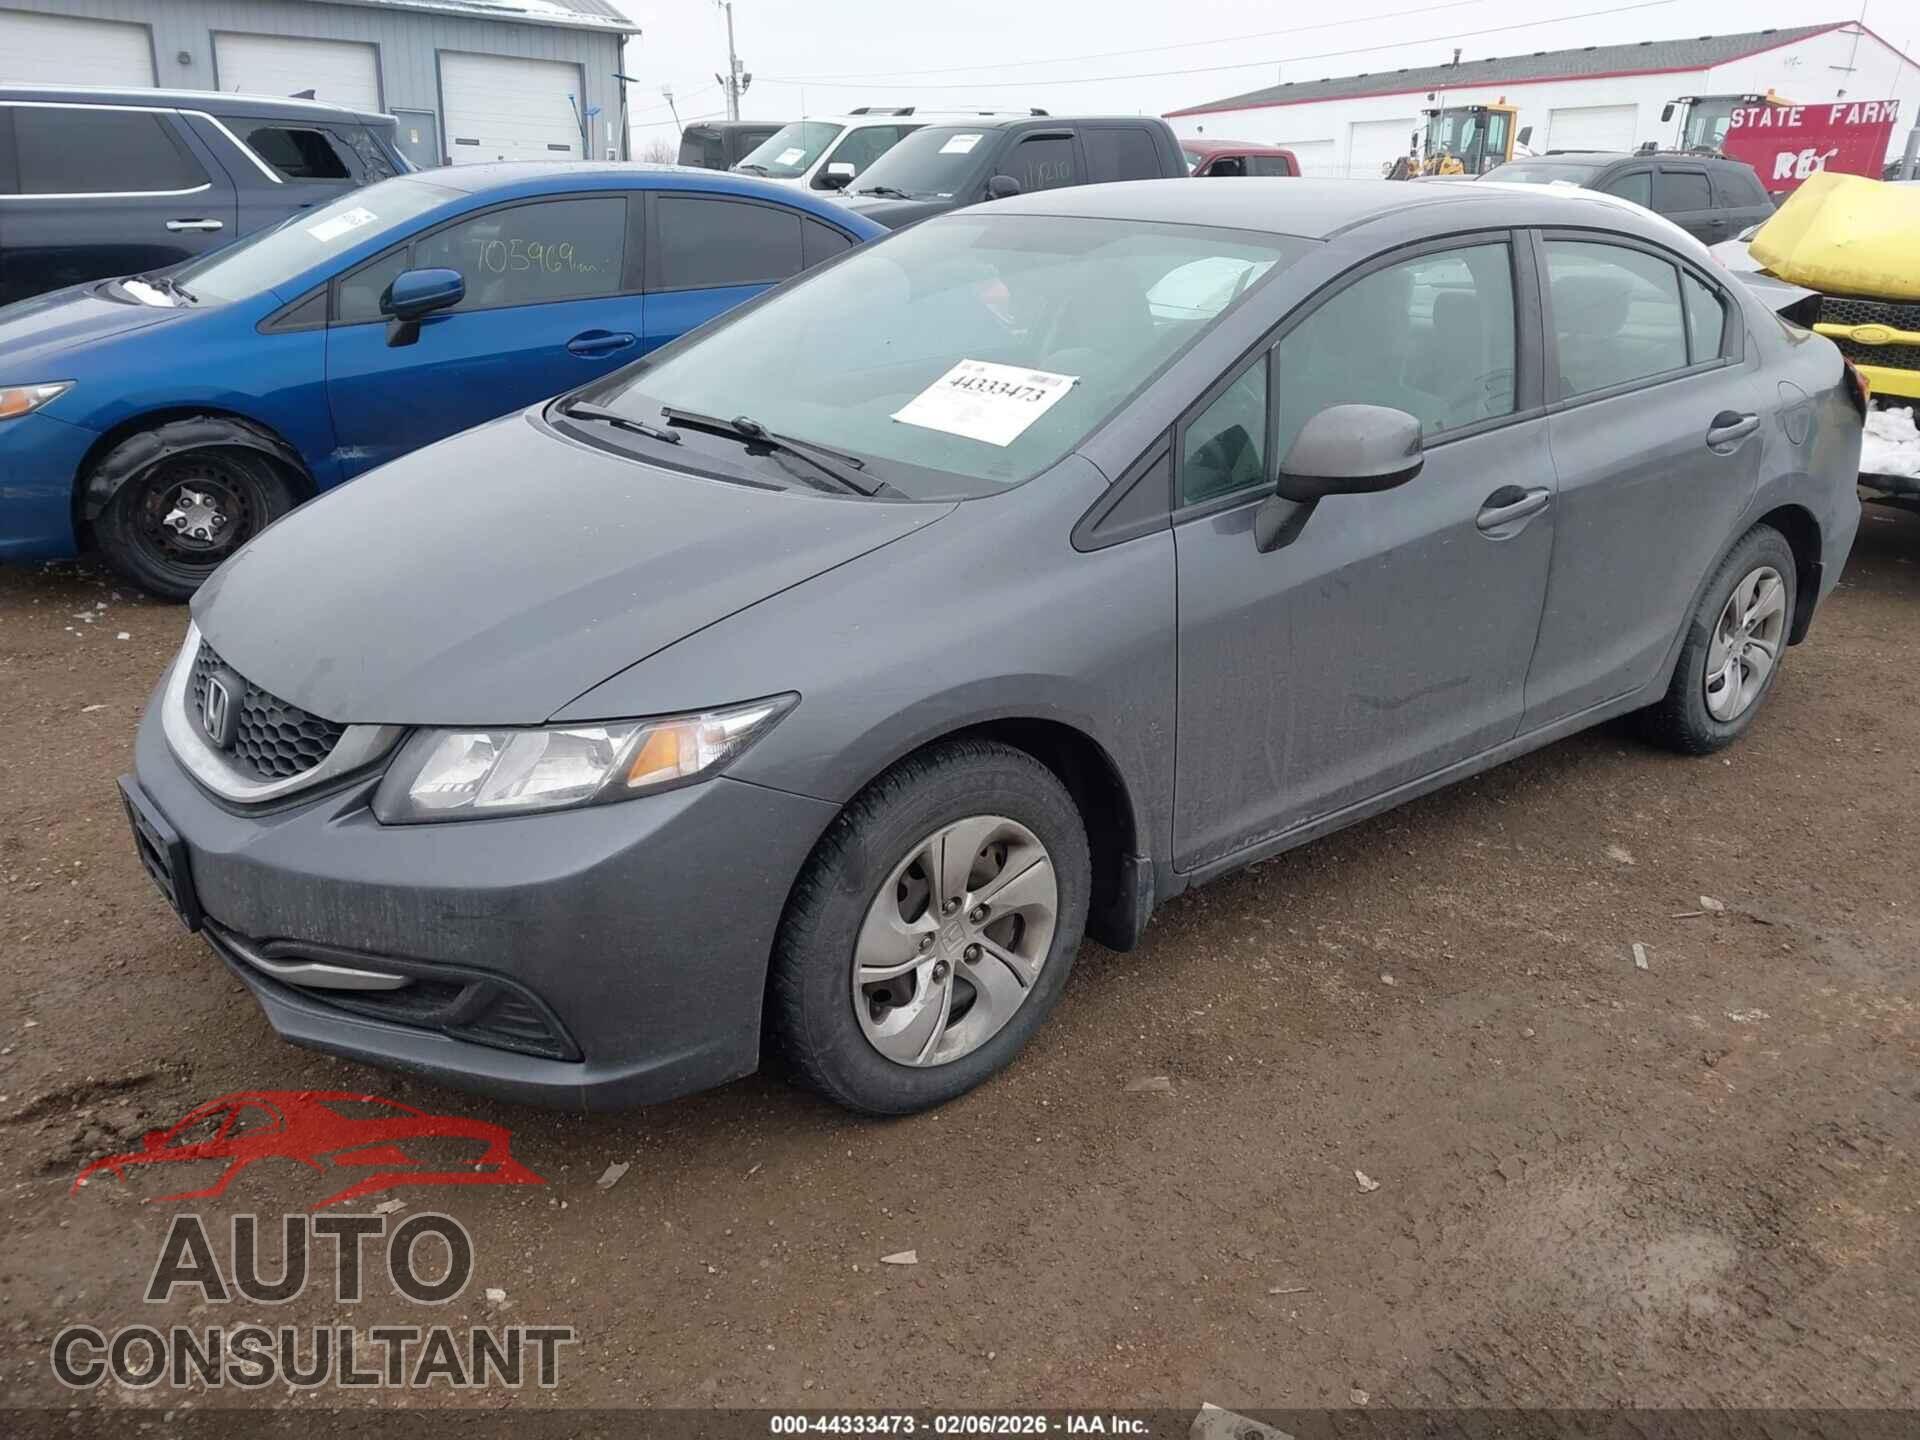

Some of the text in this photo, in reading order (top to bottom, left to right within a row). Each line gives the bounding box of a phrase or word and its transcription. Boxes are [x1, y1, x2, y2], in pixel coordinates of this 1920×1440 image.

[1731, 101, 1899, 128] STATE FARM
[950, 375, 1046, 402] 44333473
